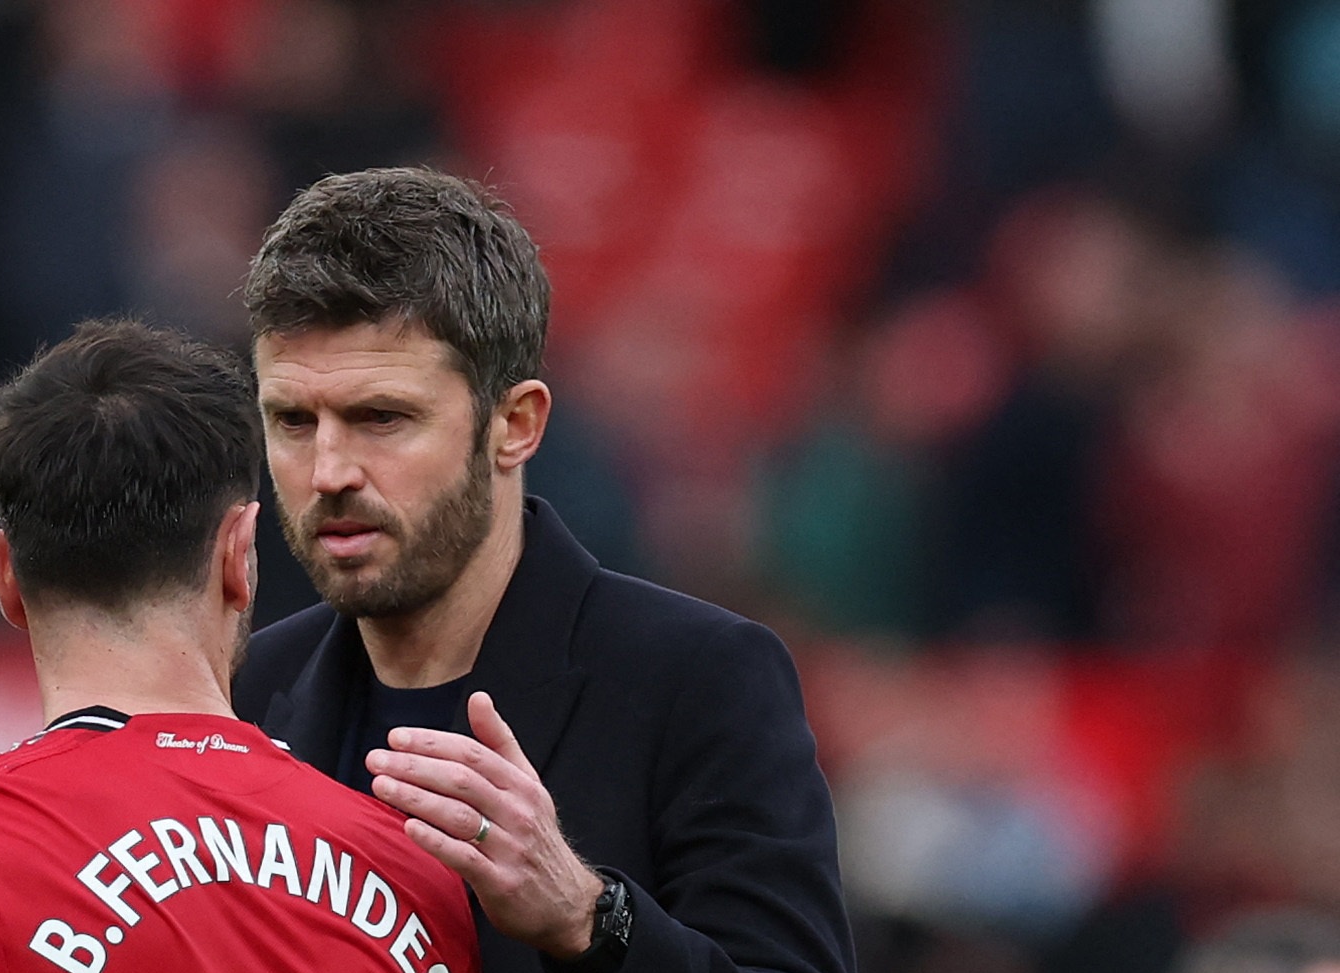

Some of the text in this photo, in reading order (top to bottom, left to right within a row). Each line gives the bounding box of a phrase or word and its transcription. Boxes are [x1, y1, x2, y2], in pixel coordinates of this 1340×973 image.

[155, 732, 250, 755] Theatre of Dreams
